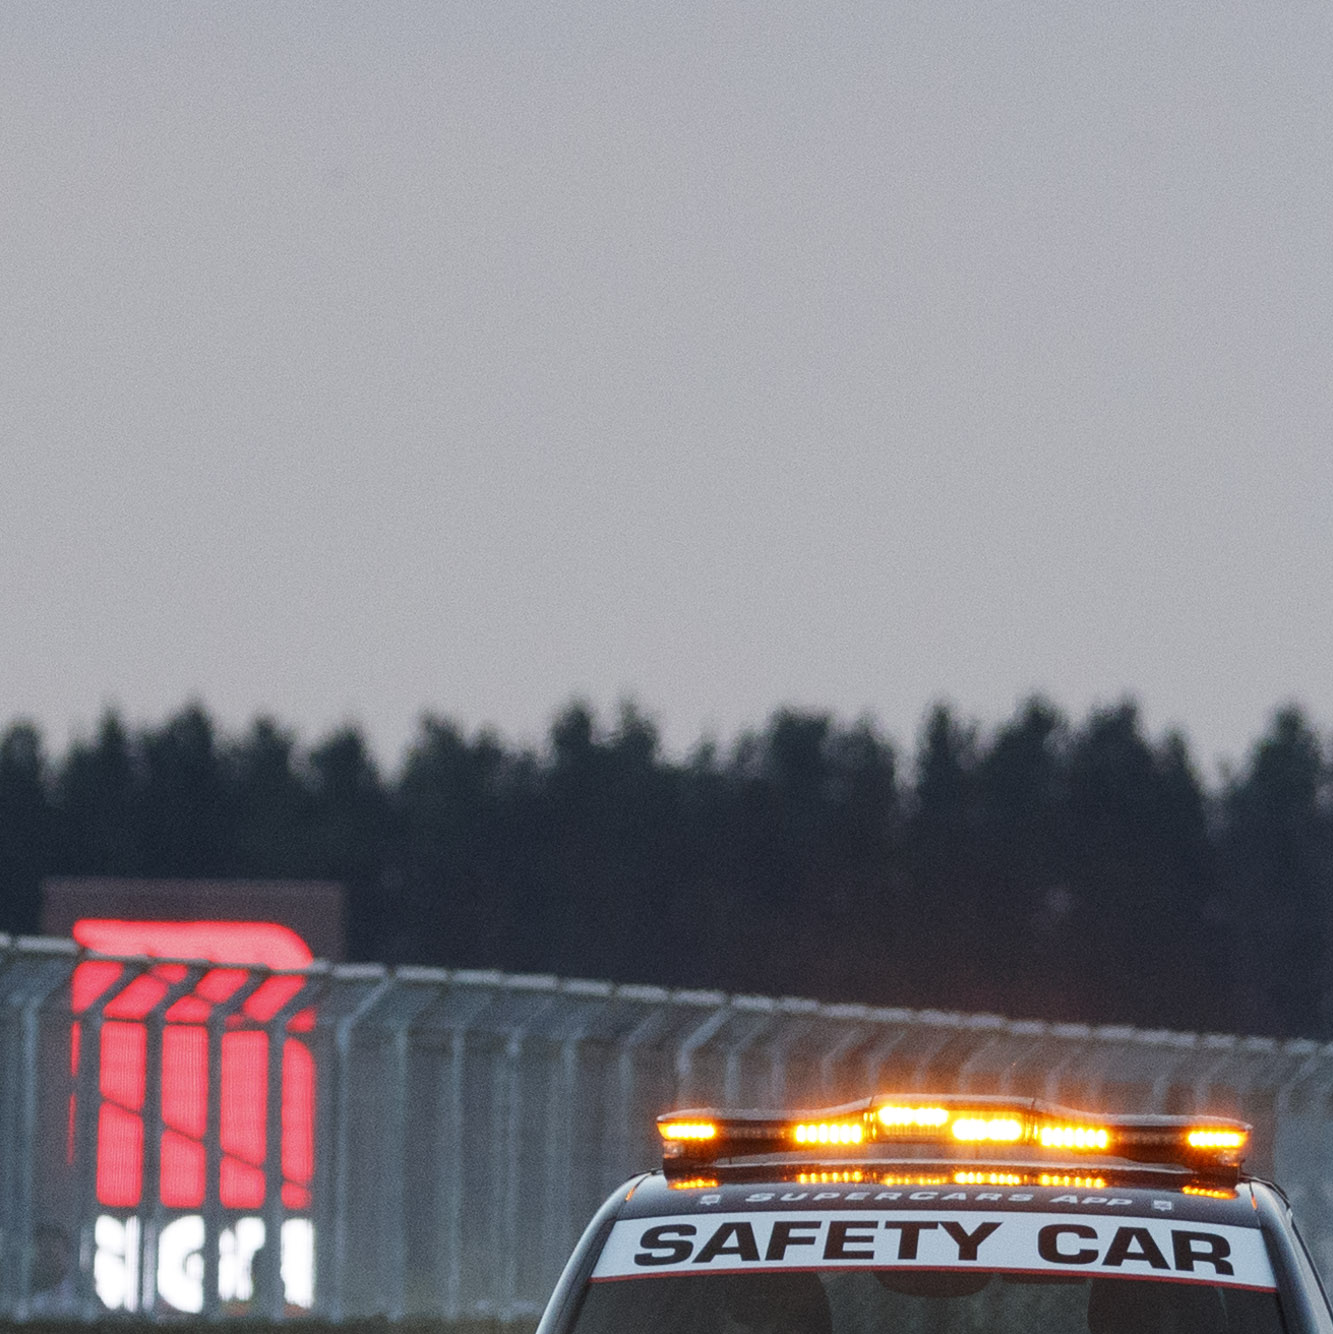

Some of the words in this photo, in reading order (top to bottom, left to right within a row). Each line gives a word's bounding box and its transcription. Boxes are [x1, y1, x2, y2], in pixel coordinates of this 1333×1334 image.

[743, 1190, 1034, 1203] SUPERCARS
[1048, 1193, 1133, 1207] APP
[633, 1218, 1004, 1269] SAFETY
[1037, 1222, 1235, 1276] CAR
